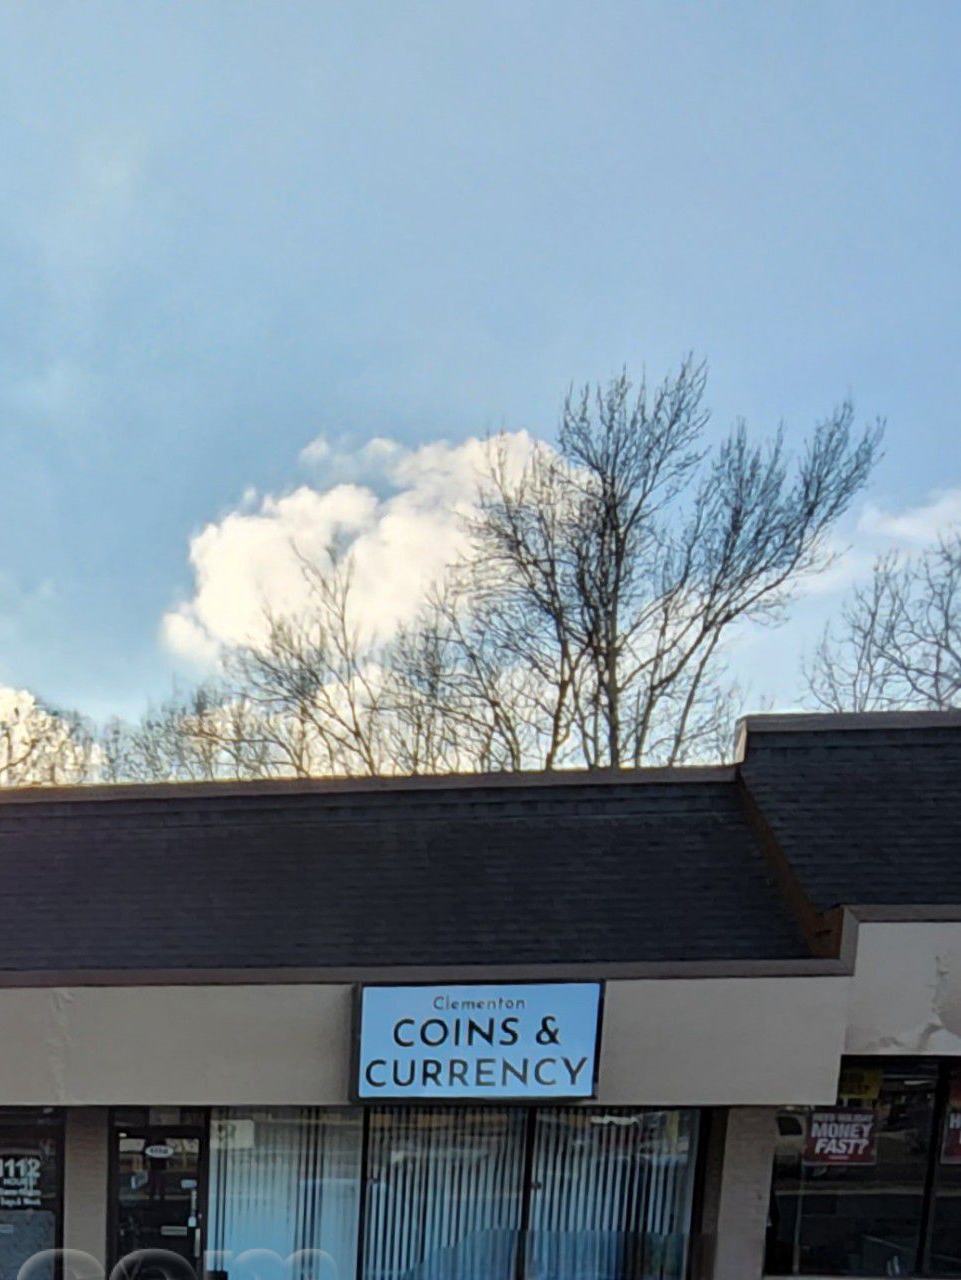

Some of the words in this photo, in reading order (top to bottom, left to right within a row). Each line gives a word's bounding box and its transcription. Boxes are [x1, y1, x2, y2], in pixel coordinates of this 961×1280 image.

[432, 995, 526, 1011] Clementon
[393, 1016, 519, 1048] COINS
[535, 1015, 561, 1046] &
[364, 1056, 588, 1088] CURRENCY
[810, 1123, 874, 1138] MONEY
[814, 1138, 870, 1155] FAST?
